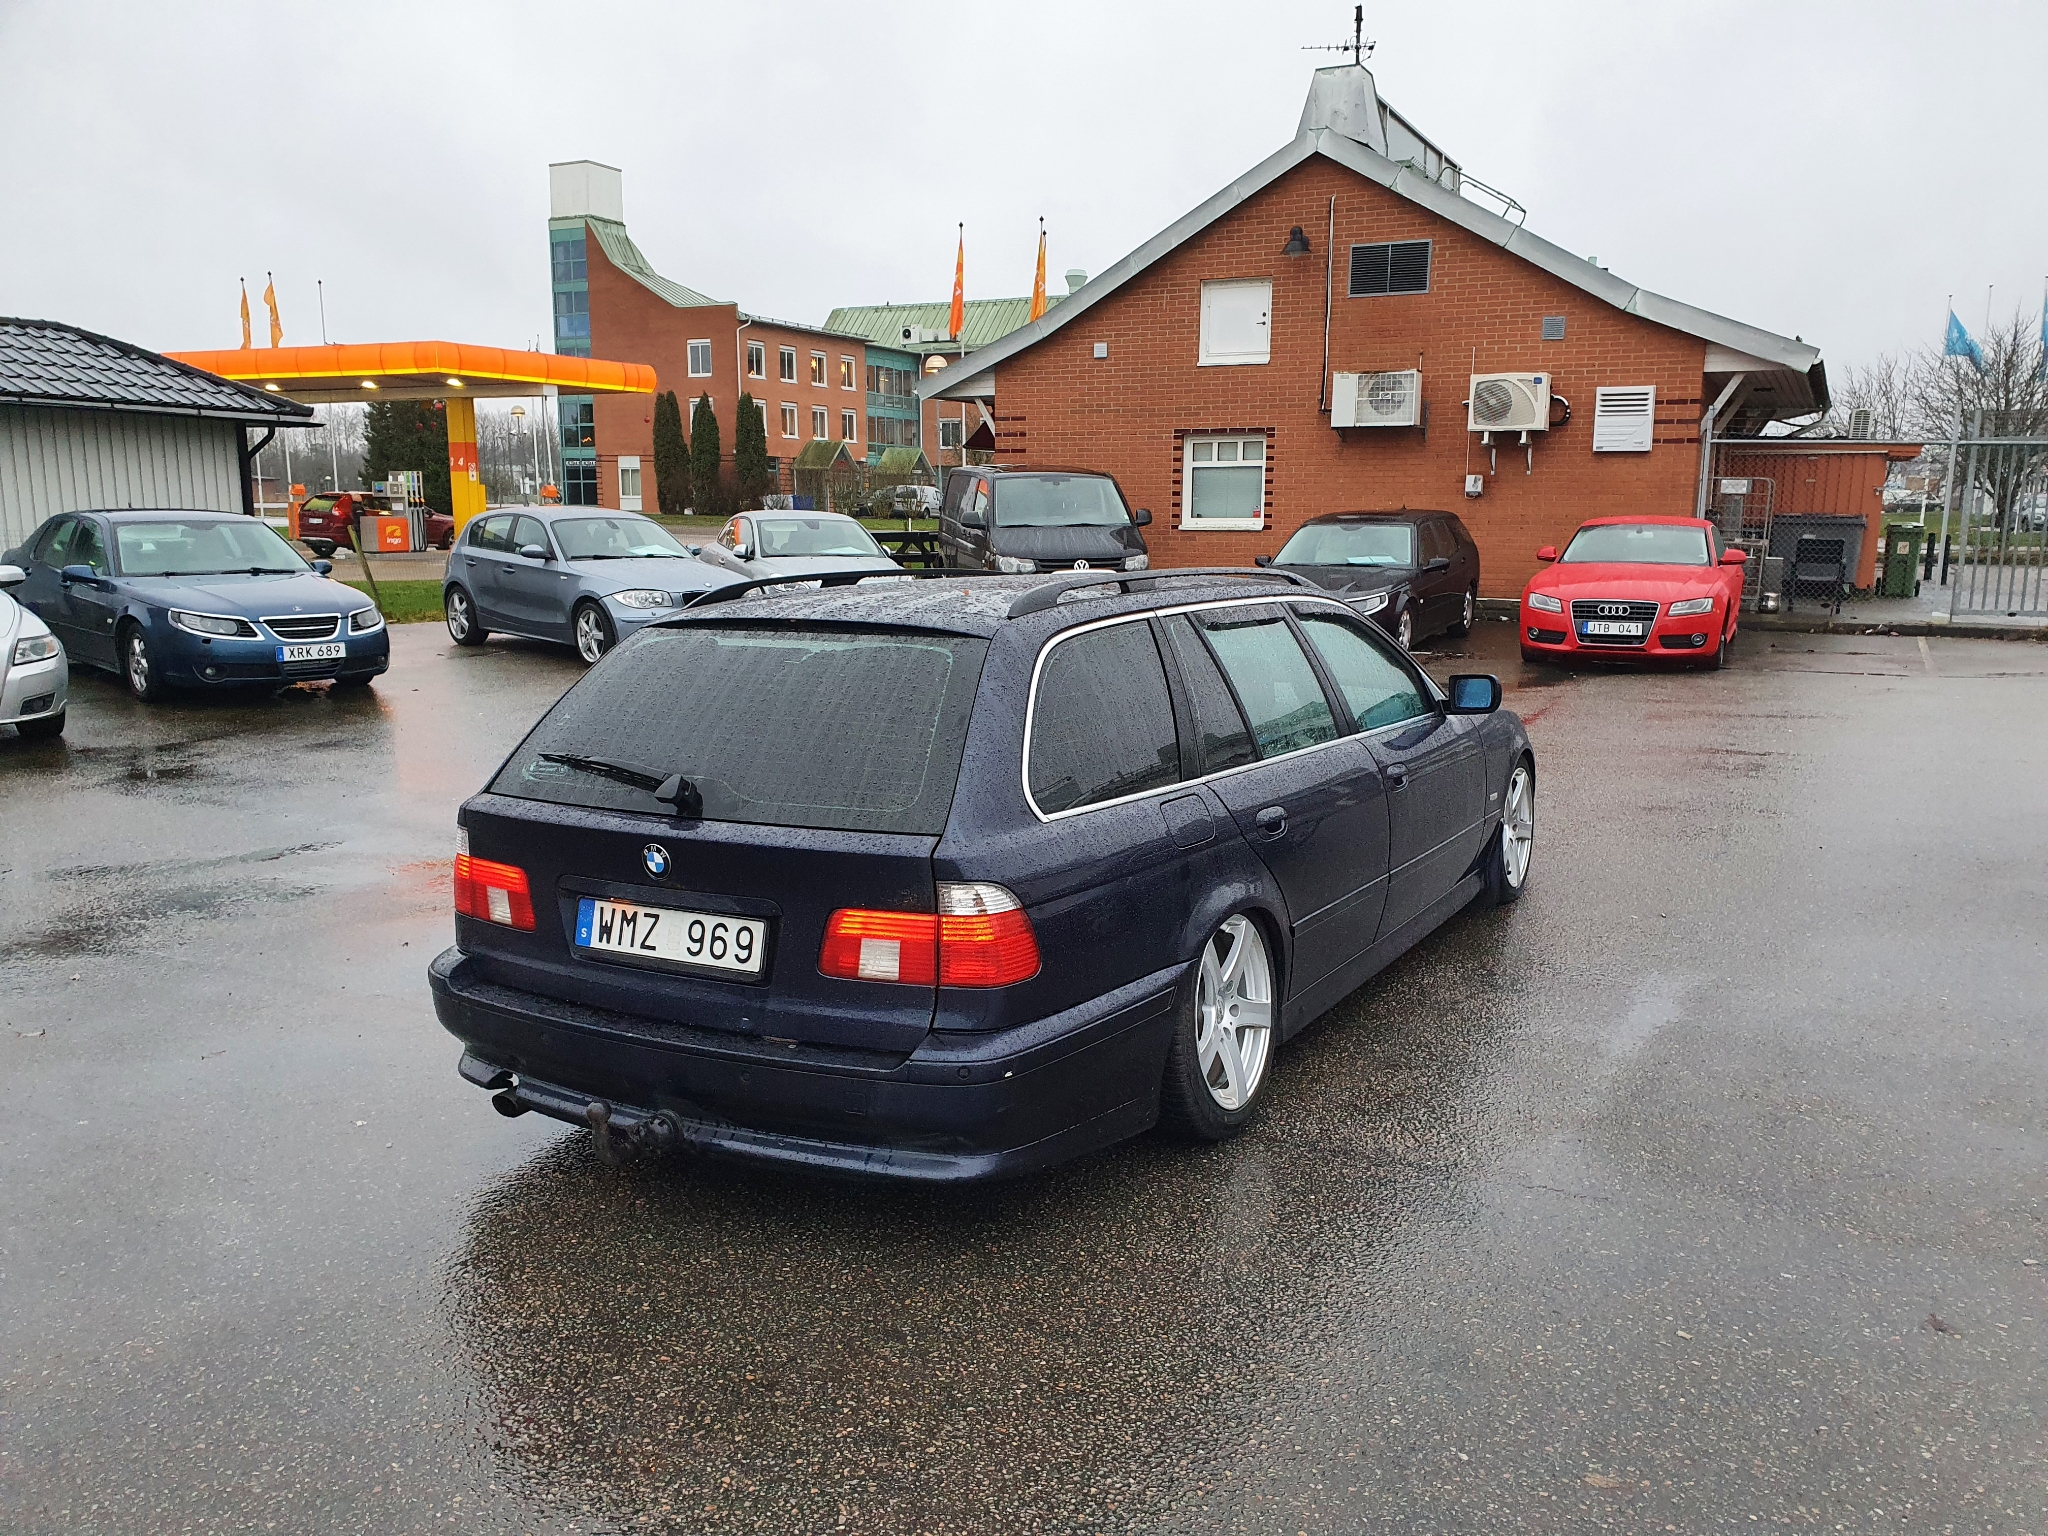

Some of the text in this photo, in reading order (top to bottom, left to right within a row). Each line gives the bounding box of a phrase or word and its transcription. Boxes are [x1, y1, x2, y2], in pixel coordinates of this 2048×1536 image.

[386, 537, 402, 545] ingo
[1589, 623, 1640, 634] JTB 041
[288, 644, 341, 659] XRK 689
[643, 845, 667, 858] BMW
[580, 927, 588, 939] S
[598, 906, 754, 964] WMZ 969
